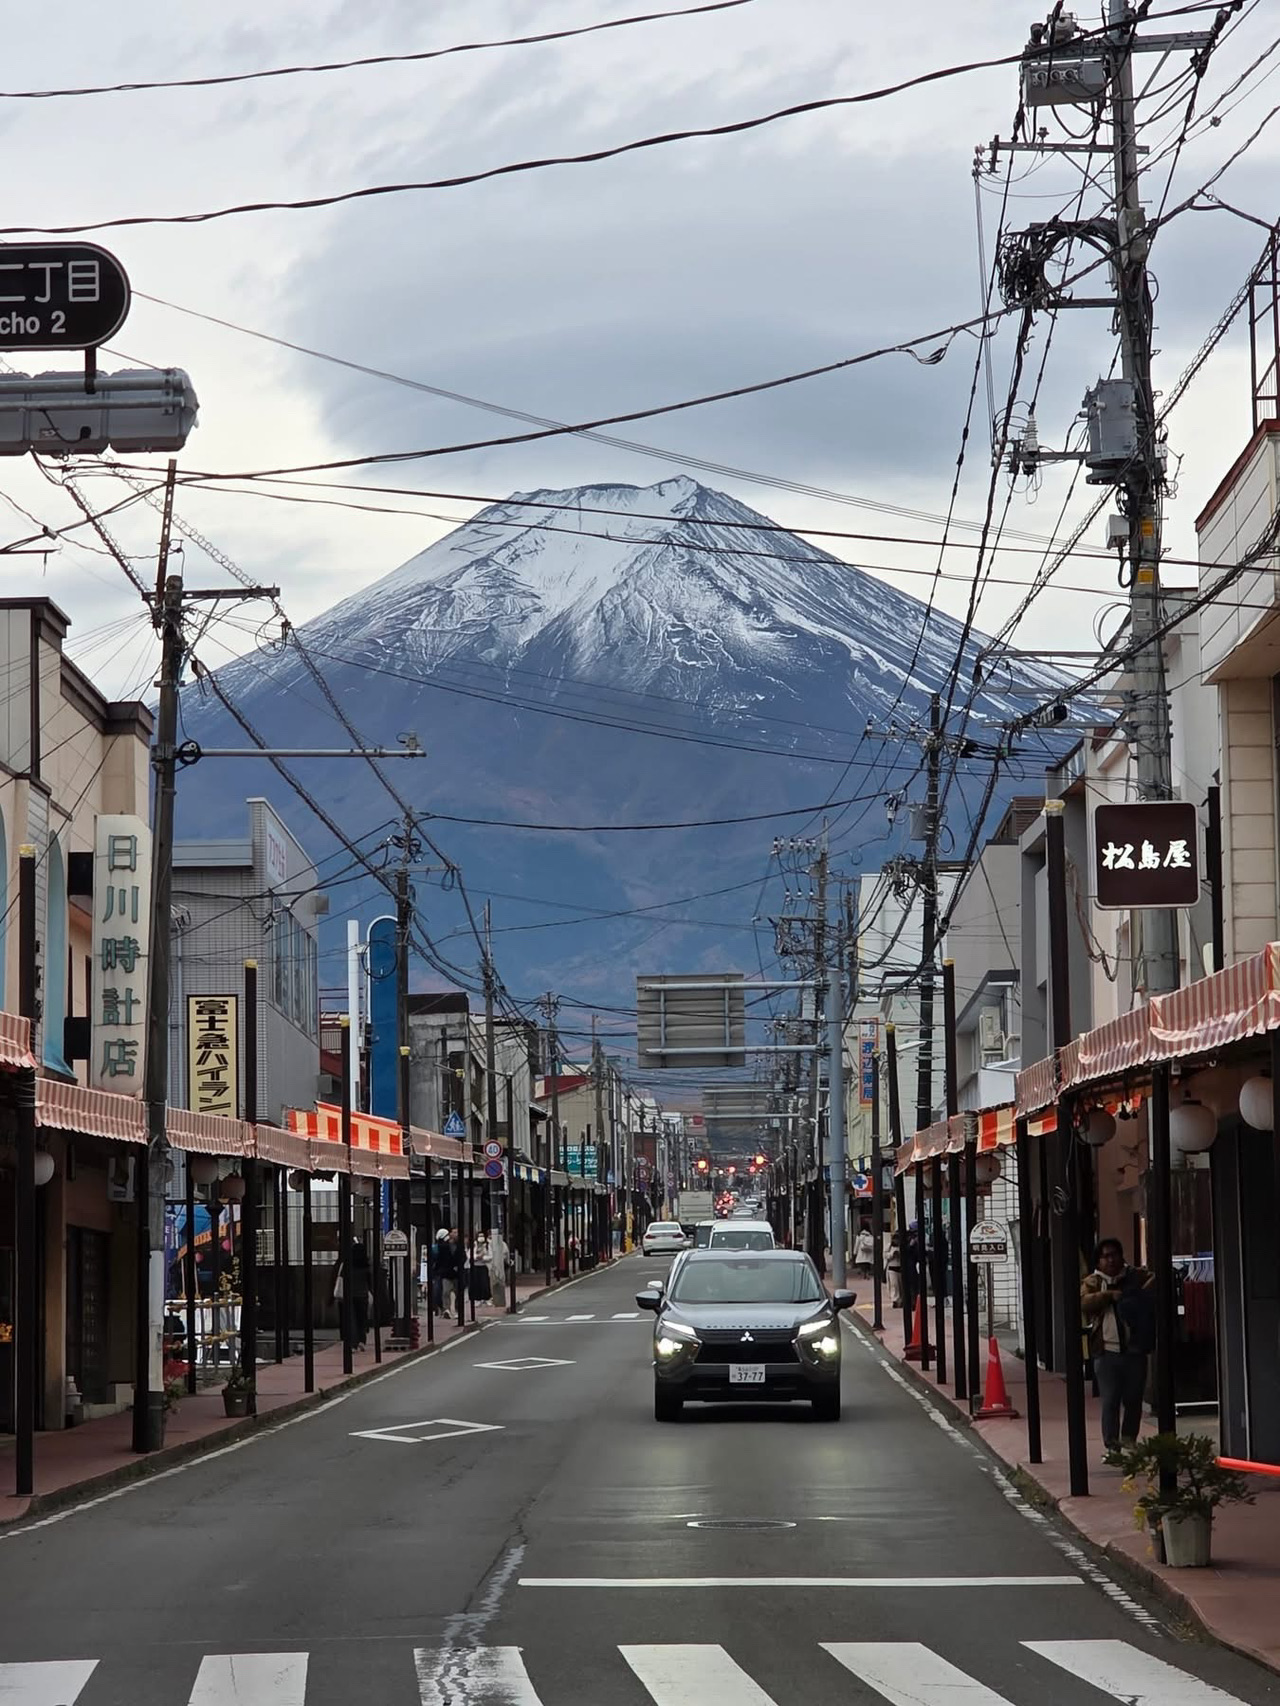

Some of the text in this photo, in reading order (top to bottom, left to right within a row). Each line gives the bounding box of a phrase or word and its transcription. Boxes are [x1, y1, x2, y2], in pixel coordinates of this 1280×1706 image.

[51, 311, 66, 333] 2
[1101, 839, 1192, 870] 松島屋
[102, 834, 141, 1078] 日川時計店
[195, 999, 231, 1117] 富士急ハイラン
[737, 1372, 763, 1381] 37-77
